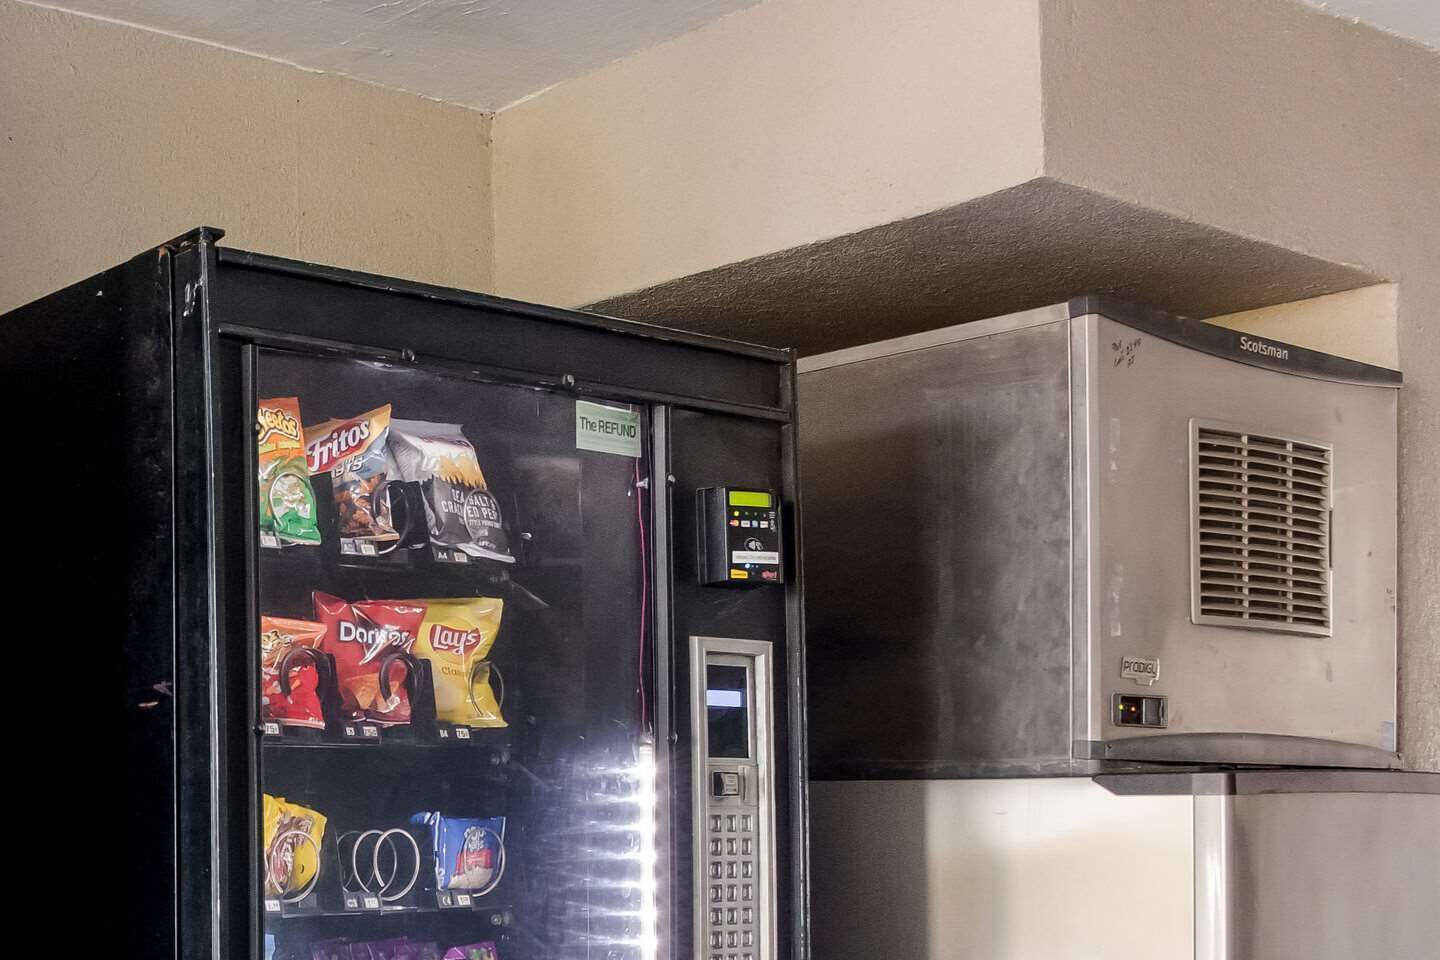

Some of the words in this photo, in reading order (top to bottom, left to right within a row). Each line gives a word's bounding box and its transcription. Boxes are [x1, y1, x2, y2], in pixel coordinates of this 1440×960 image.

[1239, 336, 1289, 360] Scotsman
[579, 415, 597, 432] The
[598, 419, 637, 438] REFUND
[307, 420, 370, 473] Fritos
[432, 624, 479, 656] Lay's
